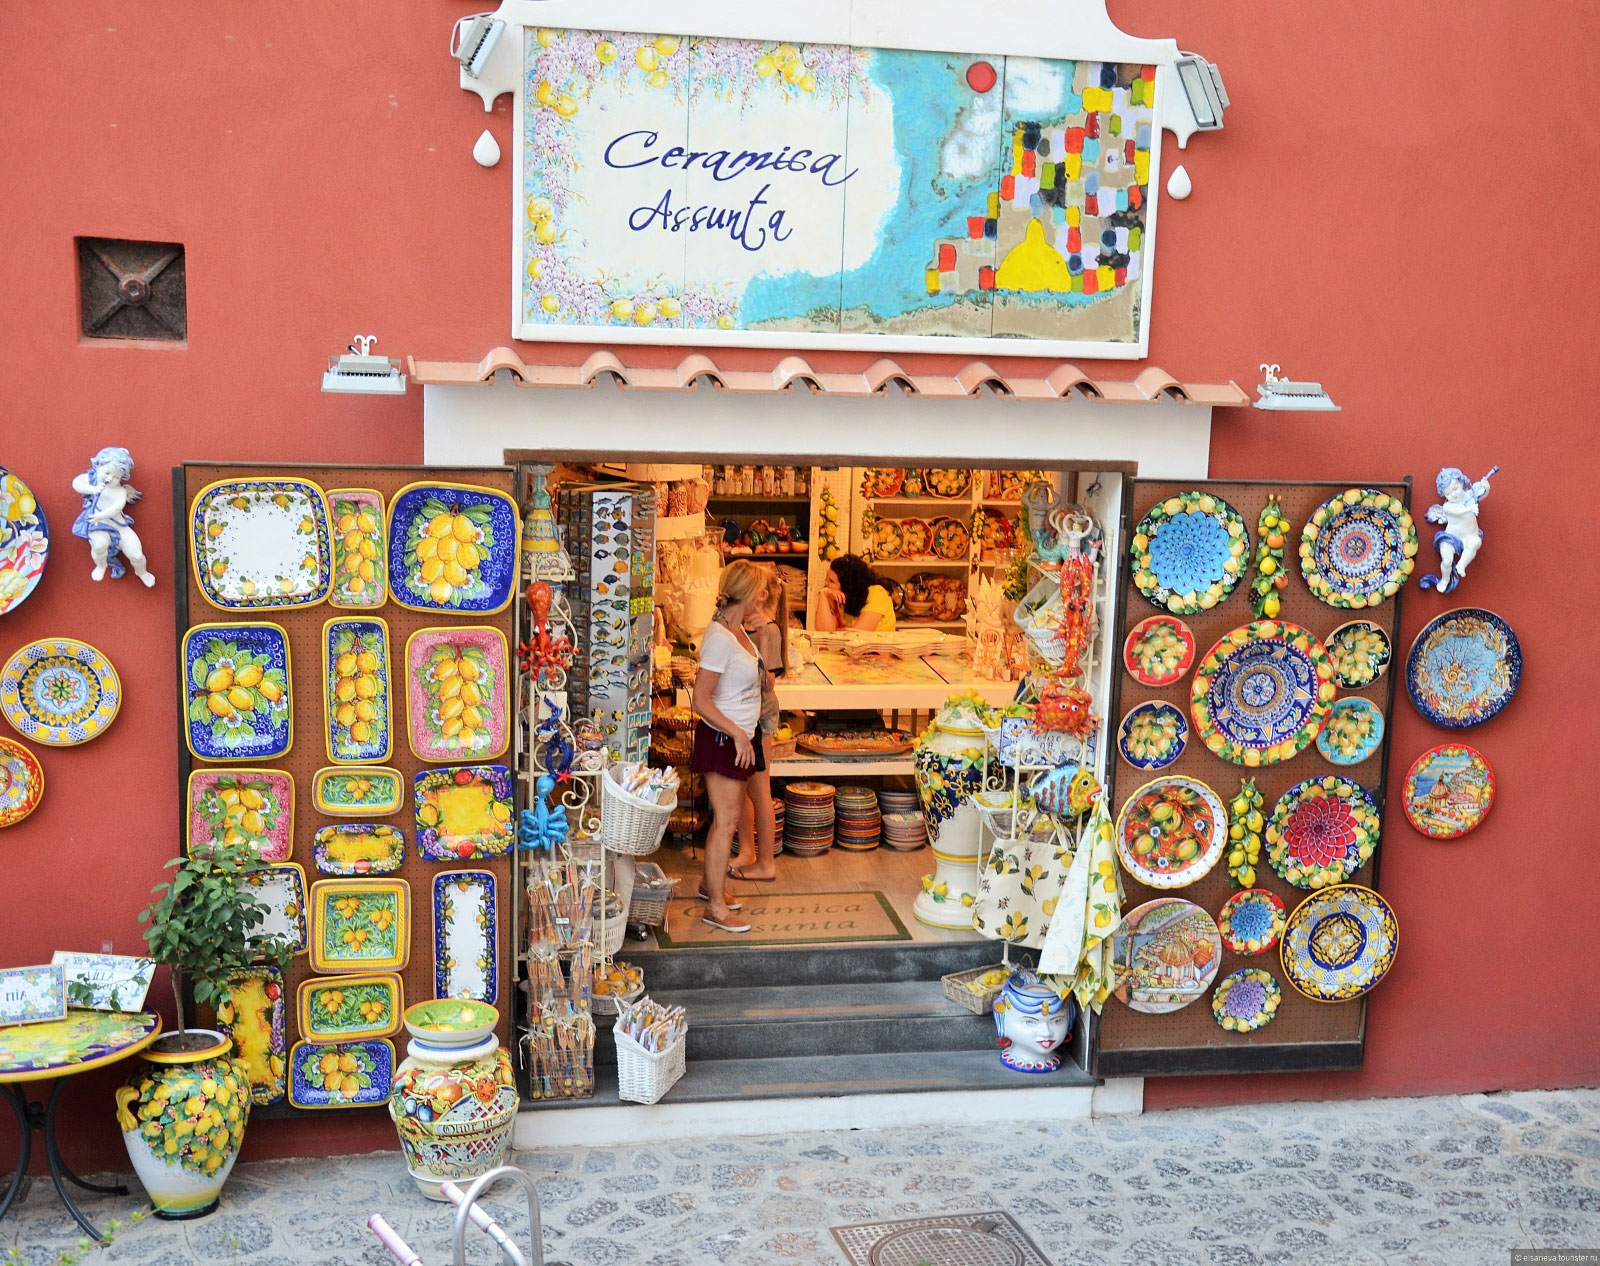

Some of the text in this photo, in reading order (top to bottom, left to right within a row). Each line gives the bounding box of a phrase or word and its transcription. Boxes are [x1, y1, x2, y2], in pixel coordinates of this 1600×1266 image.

[604, 131, 858, 185] Ceramica
[629, 184, 792, 251] Assunta
[683, 902, 863, 918] Cramica
